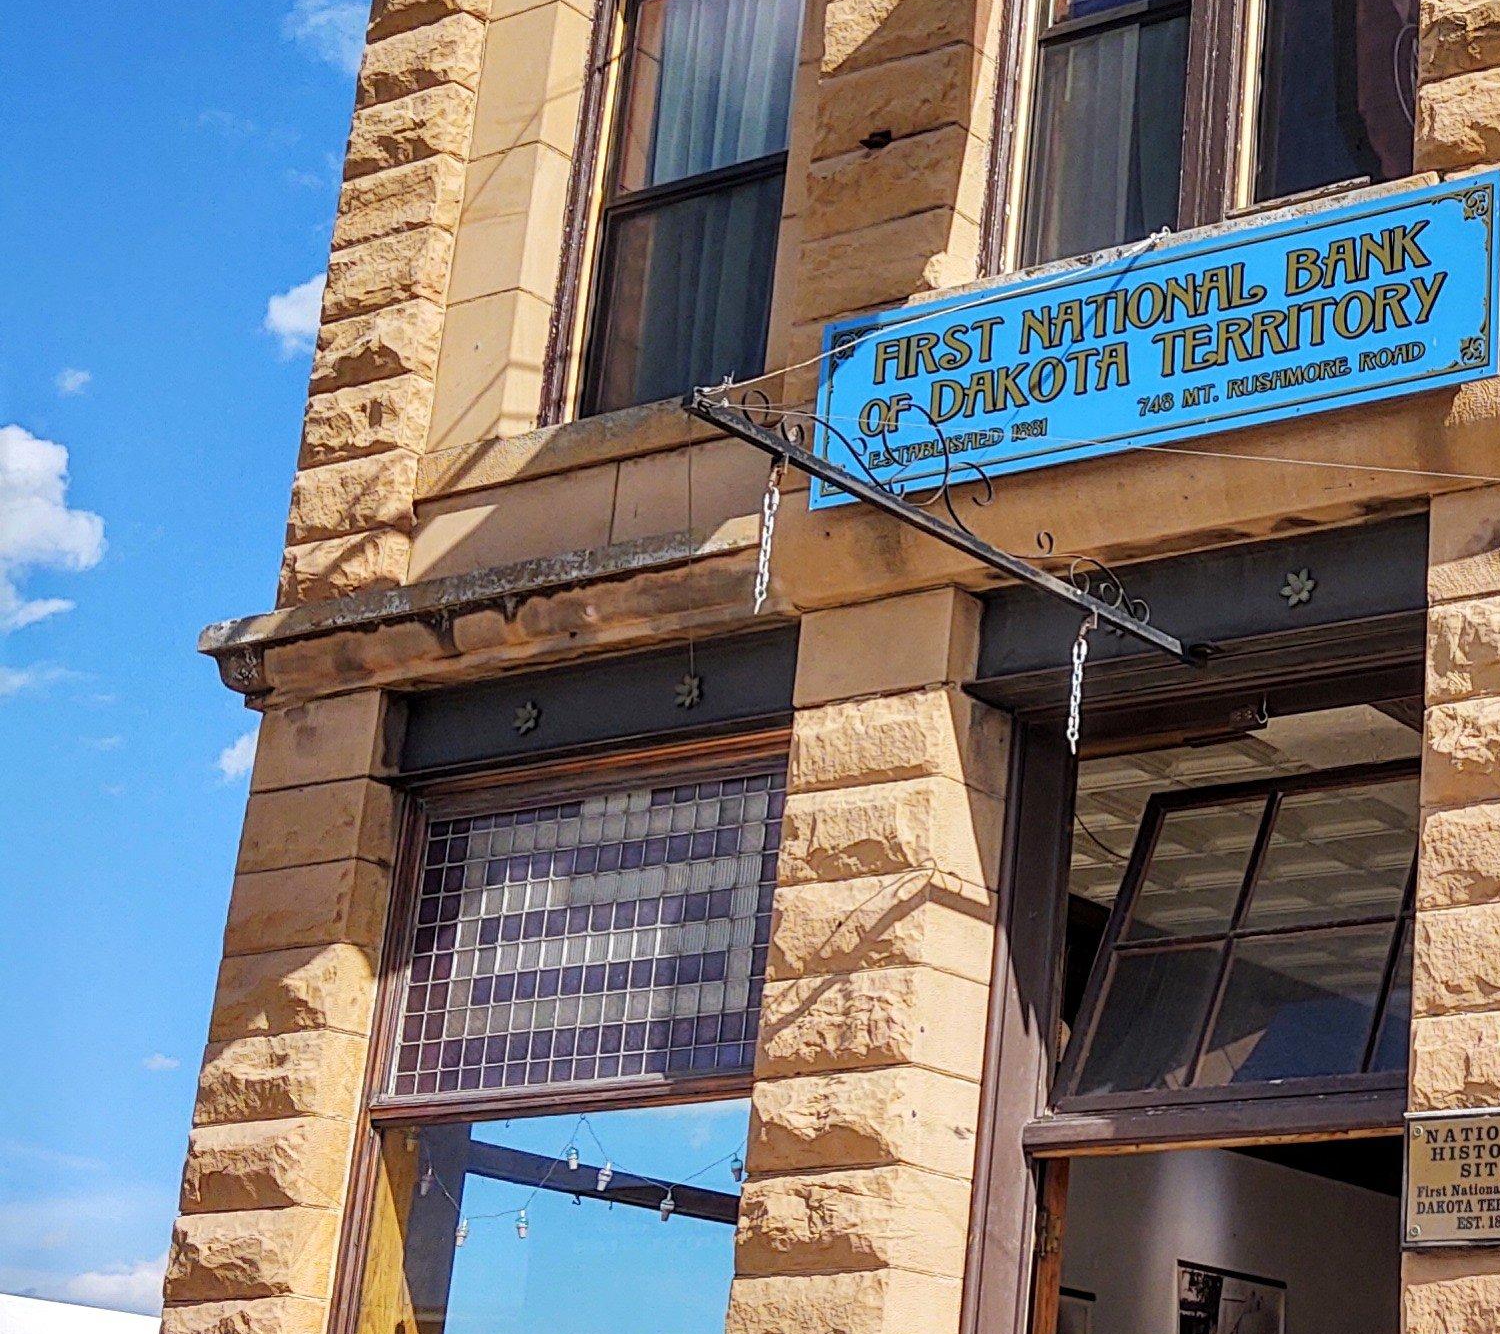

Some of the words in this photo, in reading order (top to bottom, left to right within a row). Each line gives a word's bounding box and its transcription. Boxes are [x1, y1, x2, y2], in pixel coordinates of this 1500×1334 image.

[875, 319, 1005, 385] FIRST
[1020, 264, 1266, 353] NATIONAL
[1285, 219, 1432, 295] BANK
[859, 395, 911, 438] OF
[929, 343, 1129, 426] DAKOTA
[1154, 273, 1448, 378] TERRITORY
[1138, 394, 1174, 418] 748
[1181, 384, 1219, 410] MT.
[1226, 358, 1352, 401] RUSHMORE
[1358, 341, 1425, 373] ROAD
[867, 426, 1005, 470] ESTABLISHED
[1010, 417, 1048, 444] 1881
[1416, 1185, 1448, 1198] First
[1416, 1198, 1473, 1215] DAKOTA
[1457, 1216, 1485, 1230] EST.
